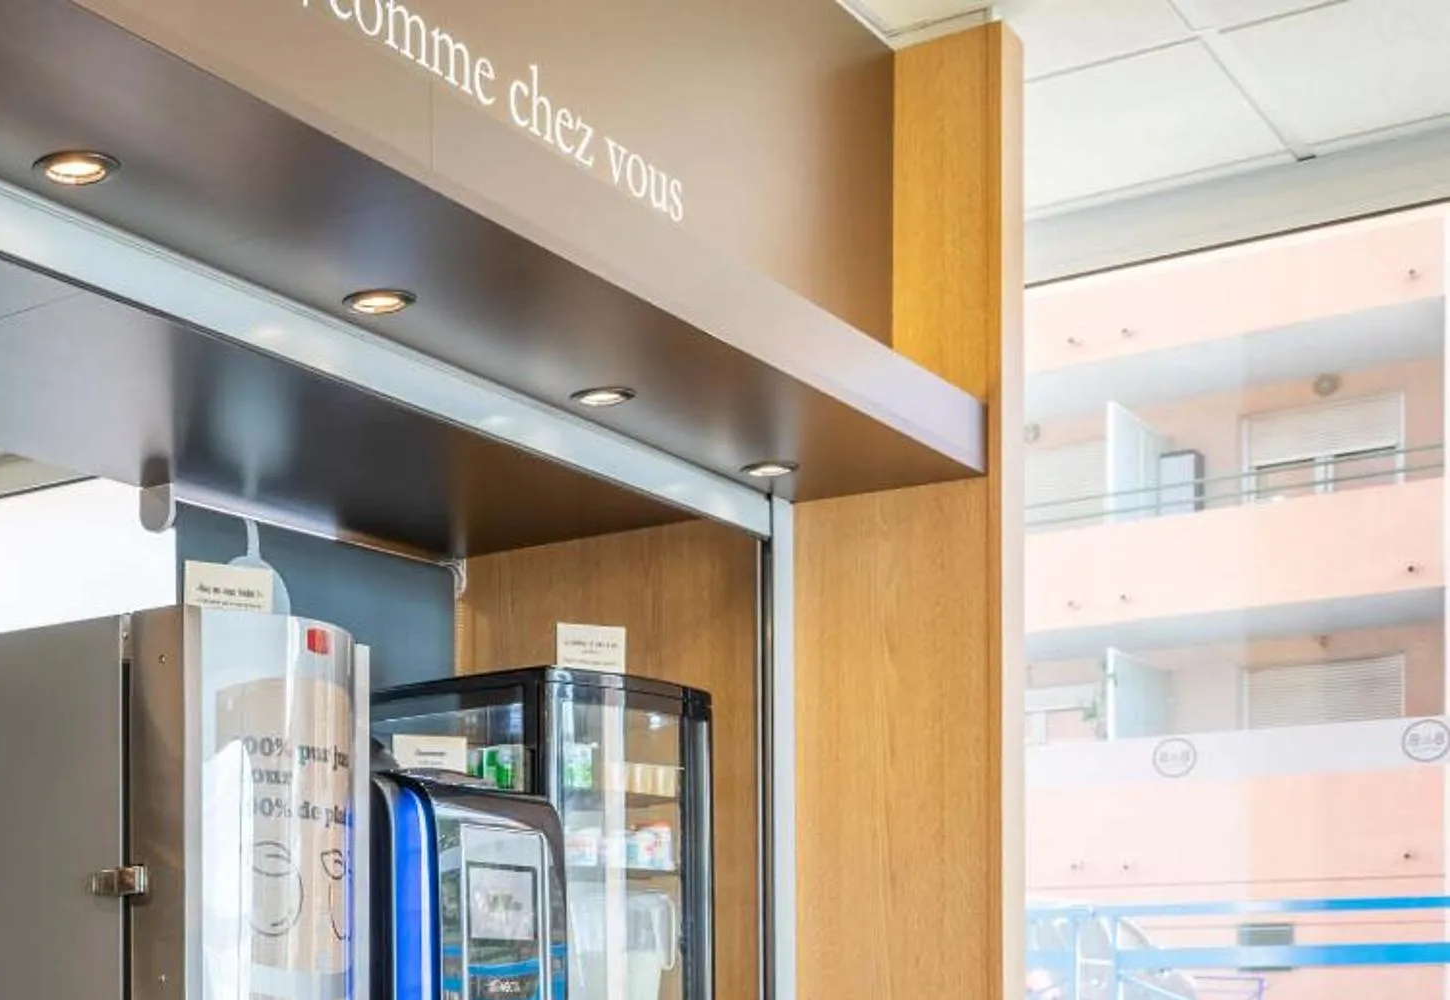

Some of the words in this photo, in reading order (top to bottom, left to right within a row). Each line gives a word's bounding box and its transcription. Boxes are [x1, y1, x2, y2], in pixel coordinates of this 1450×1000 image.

[509, 64, 595, 168] chez
[603, 136, 684, 223] vous
[242, 736, 293, 757] 00%
